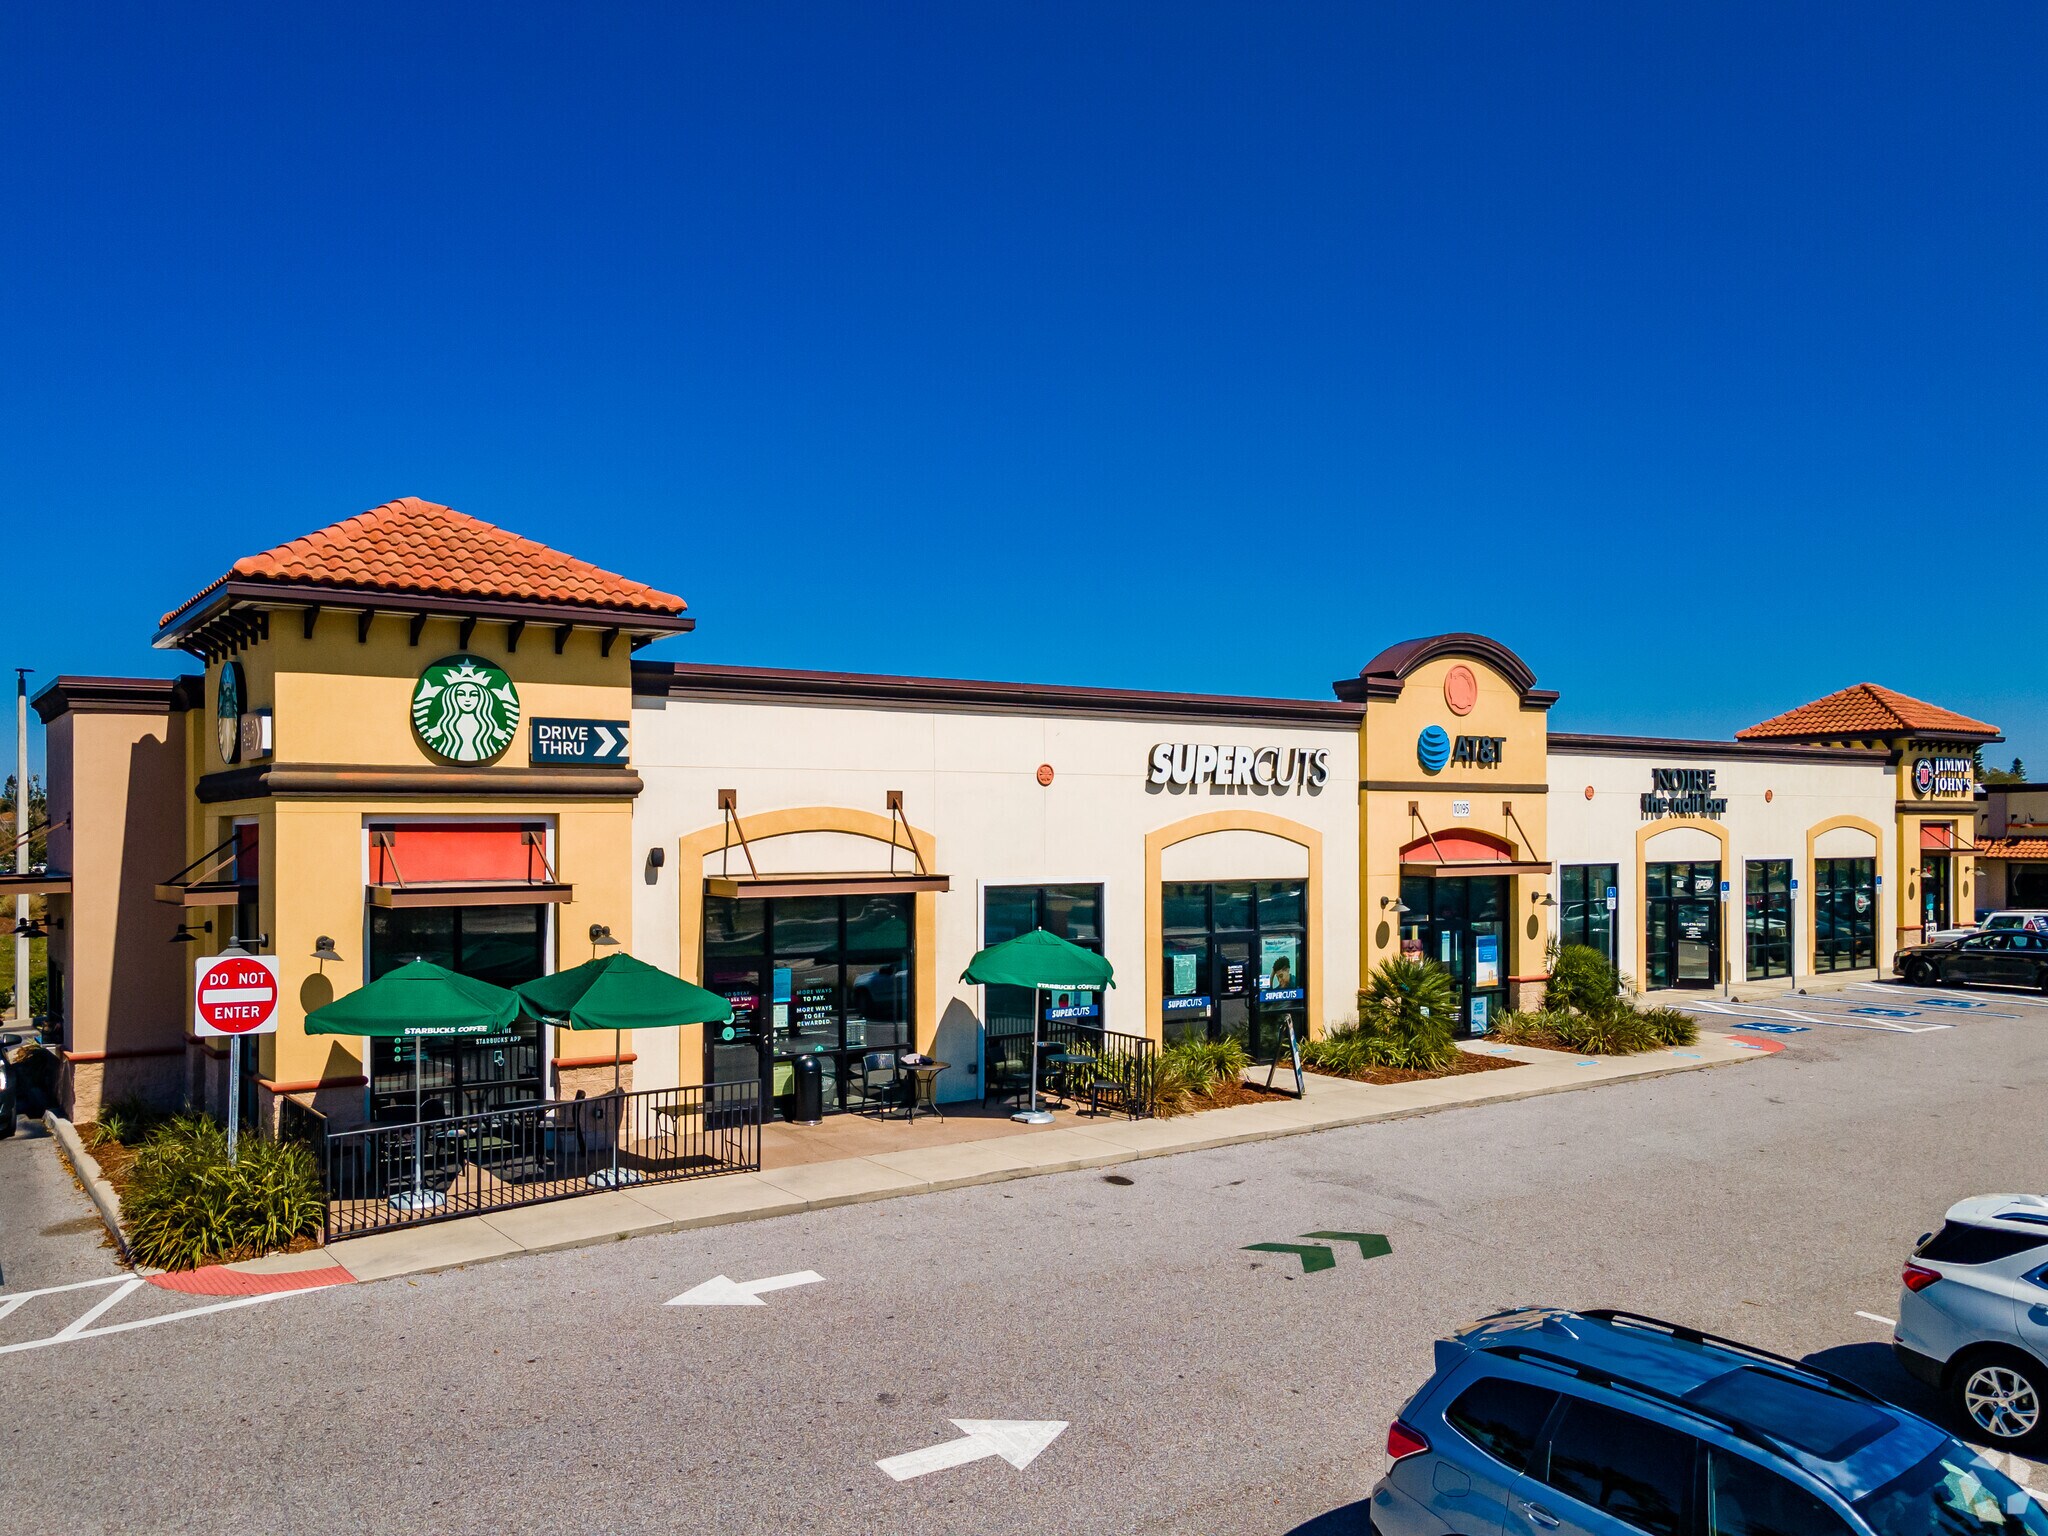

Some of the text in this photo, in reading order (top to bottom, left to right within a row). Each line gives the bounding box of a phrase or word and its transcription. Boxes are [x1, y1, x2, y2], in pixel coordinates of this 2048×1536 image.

[539, 725, 588, 740] DRIVE
[539, 741, 585, 755] THRU
[1452, 735, 1506, 763] AT&T
[1150, 743, 1331, 788] SUPERCUTS
[1934, 758, 1971, 774] JIMMY
[1652, 768, 1716, 791] NOIRE
[1934, 778, 1972, 794] JOHN'S
[1453, 803, 1470, 814] 10195
[1642, 793, 1728, 813] the nail bar
[210, 972, 266, 986] DO NOT
[1037, 982, 1076, 990] STARBUCKS
[1265, 990, 1297, 1000] SUPERCUTS
[1168, 998, 1203, 1009] SUPERCUTS
[214, 1006, 260, 1019] ENTER
[1052, 1006, 1090, 1018] SUPERCUTS
[796, 1019, 832, 1027] REWARDED.
[404, 1027, 456, 1035] STARBUCKS
[458, 1025, 488, 1033] COFFEE
[475, 1037, 508, 1045] STARBUCKS
